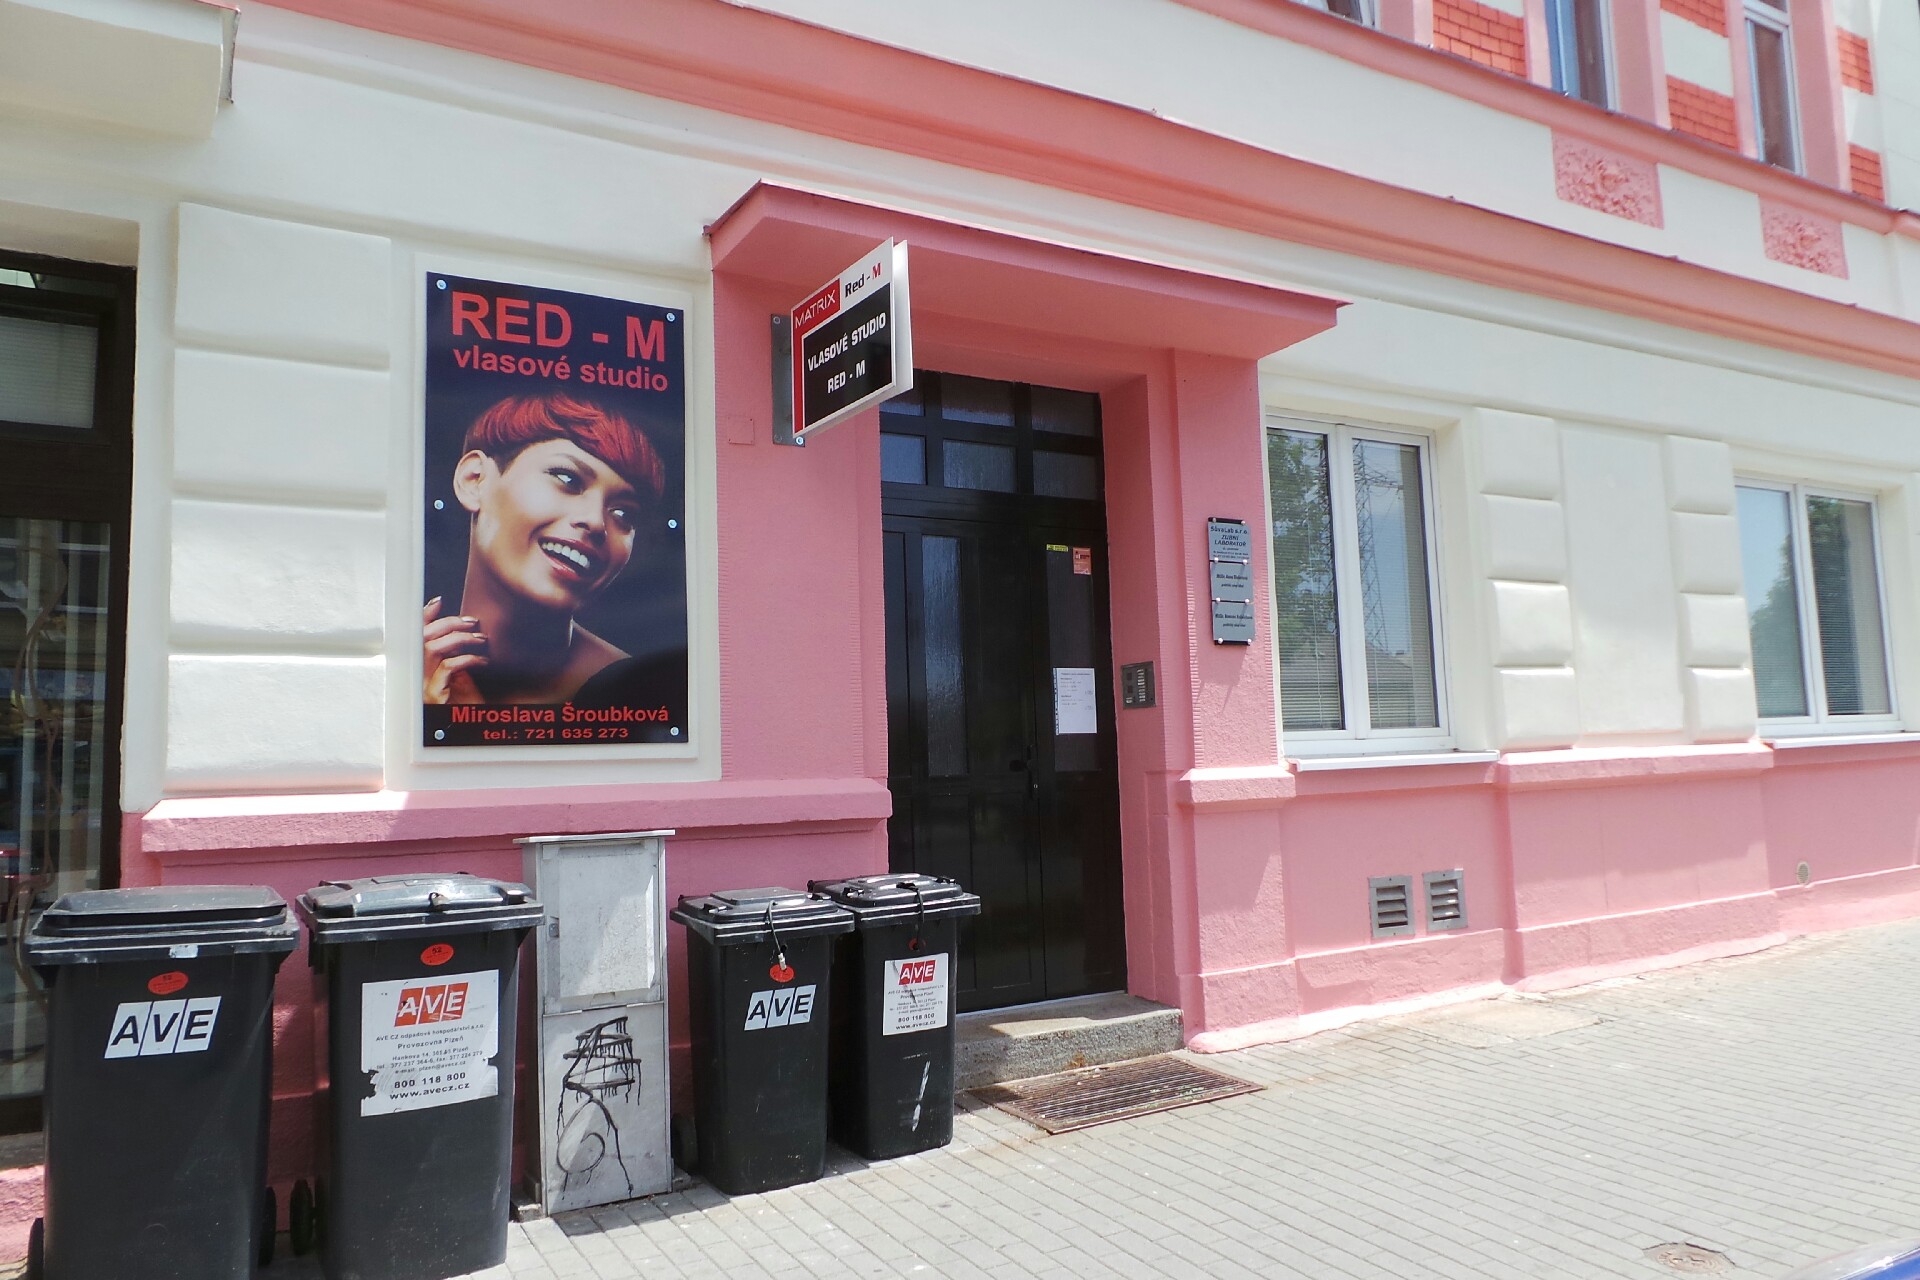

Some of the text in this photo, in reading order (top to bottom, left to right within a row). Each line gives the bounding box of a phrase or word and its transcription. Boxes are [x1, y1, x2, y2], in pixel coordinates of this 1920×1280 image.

[845, 273, 865, 298] Red
[872, 262, 881, 281] M
[795, 289, 836, 329] MATRIX
[452, 291, 665, 362] RED - M
[807, 311, 886, 371] VLASOVÉ STUDIO
[453, 345, 669, 392] vlasové studio
[827, 373, 846, 394] RED
[856, 359, 866, 379] M
[452, 702, 669, 723] Miroslava Šroubková
[483, 727, 629, 740] tel.: 721 635 273
[901, 964, 934, 980] AVE
[398, 991, 464, 1018] AVE
[748, 994, 812, 1021] AVE
[111, 1010, 214, 1046] AVE
[376, 1034, 389, 1042] AVE
[397, 1038, 442, 1049] Provozovna
[389, 1082, 470, 1100] www.avecz.cz
[394, 1072, 466, 1089] 800 118 800
